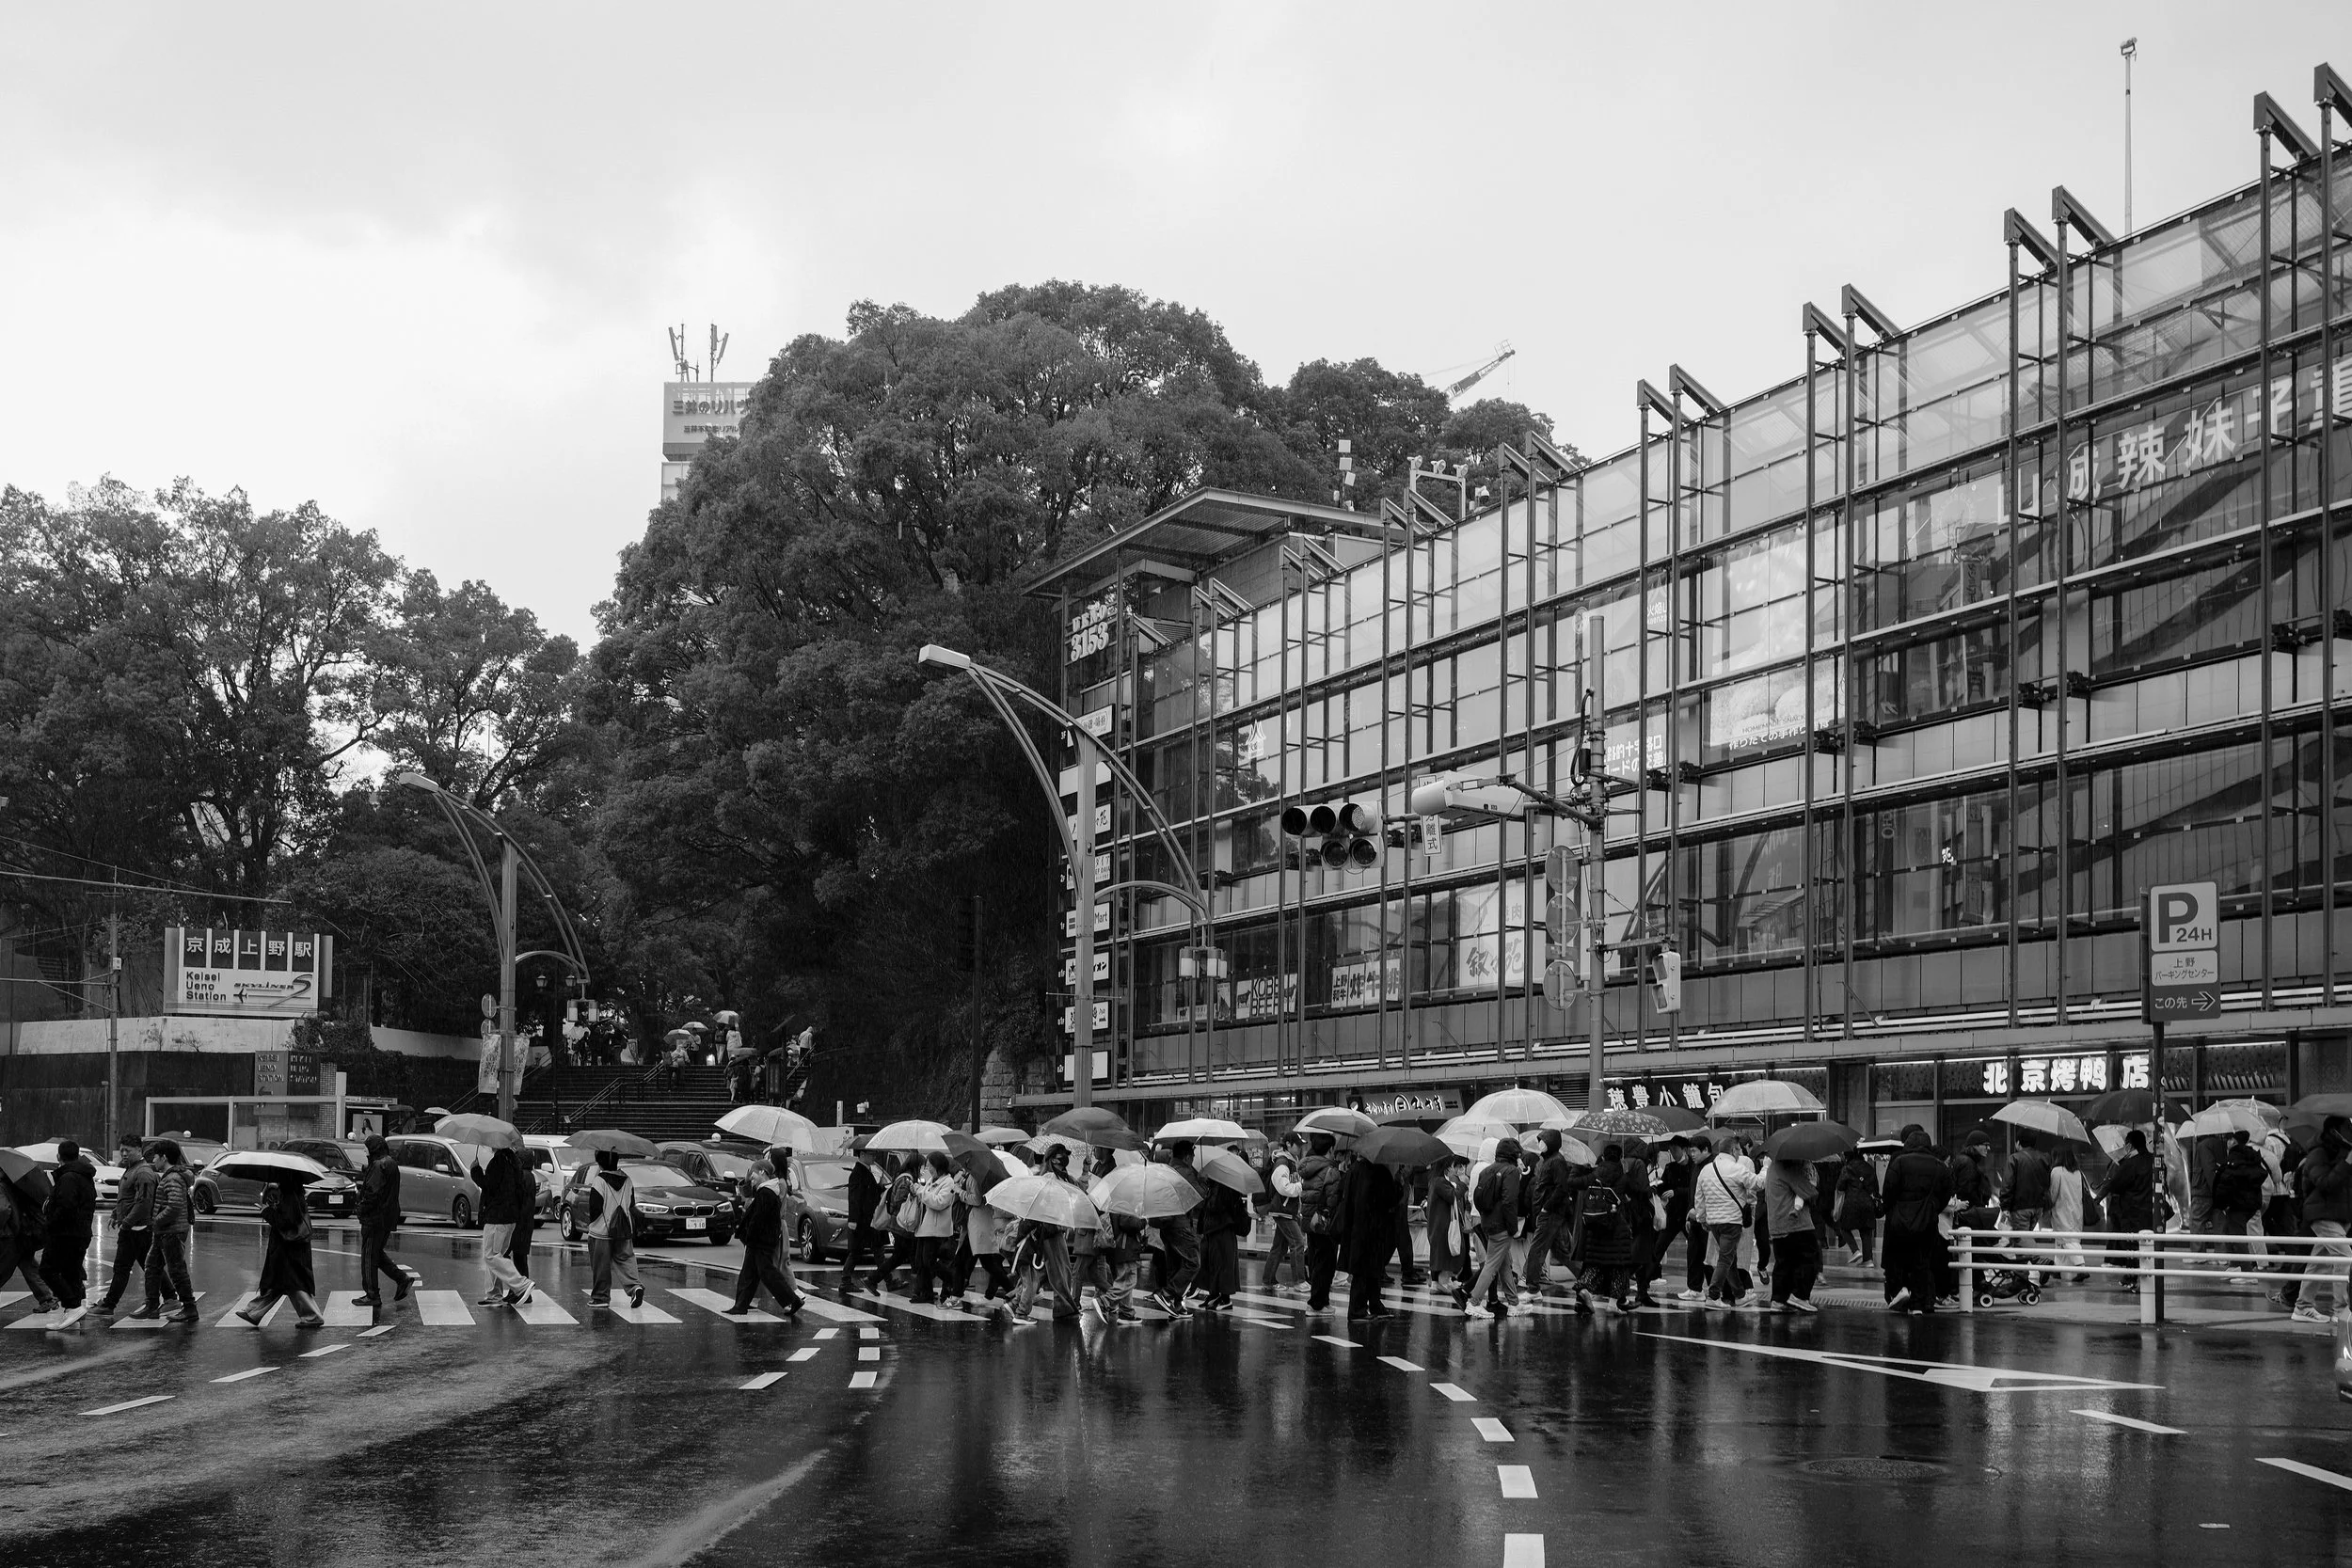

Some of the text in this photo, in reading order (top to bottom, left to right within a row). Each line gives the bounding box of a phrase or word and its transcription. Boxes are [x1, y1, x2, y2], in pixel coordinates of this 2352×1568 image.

[1072, 603, 1108, 632] UENO
[1071, 621, 1109, 662] 3153
[2158, 893, 2212, 943] P 24H
[186, 936, 312, 958] 京成上野駅
[2173, 957, 2196, 969] 上野
[185, 971, 221, 982] Keisei
[2154, 968, 2215, 981] パーキングセンター
[185, 981, 215, 991] Ueno
[185, 990, 228, 1002] Station
[1252, 975, 1279, 998] KOBE
[1252, 995, 1279, 1017] BEEF
[2154, 996, 2187, 1009] この先
[1982, 1054, 2150, 1095] 北京烤鸭店
